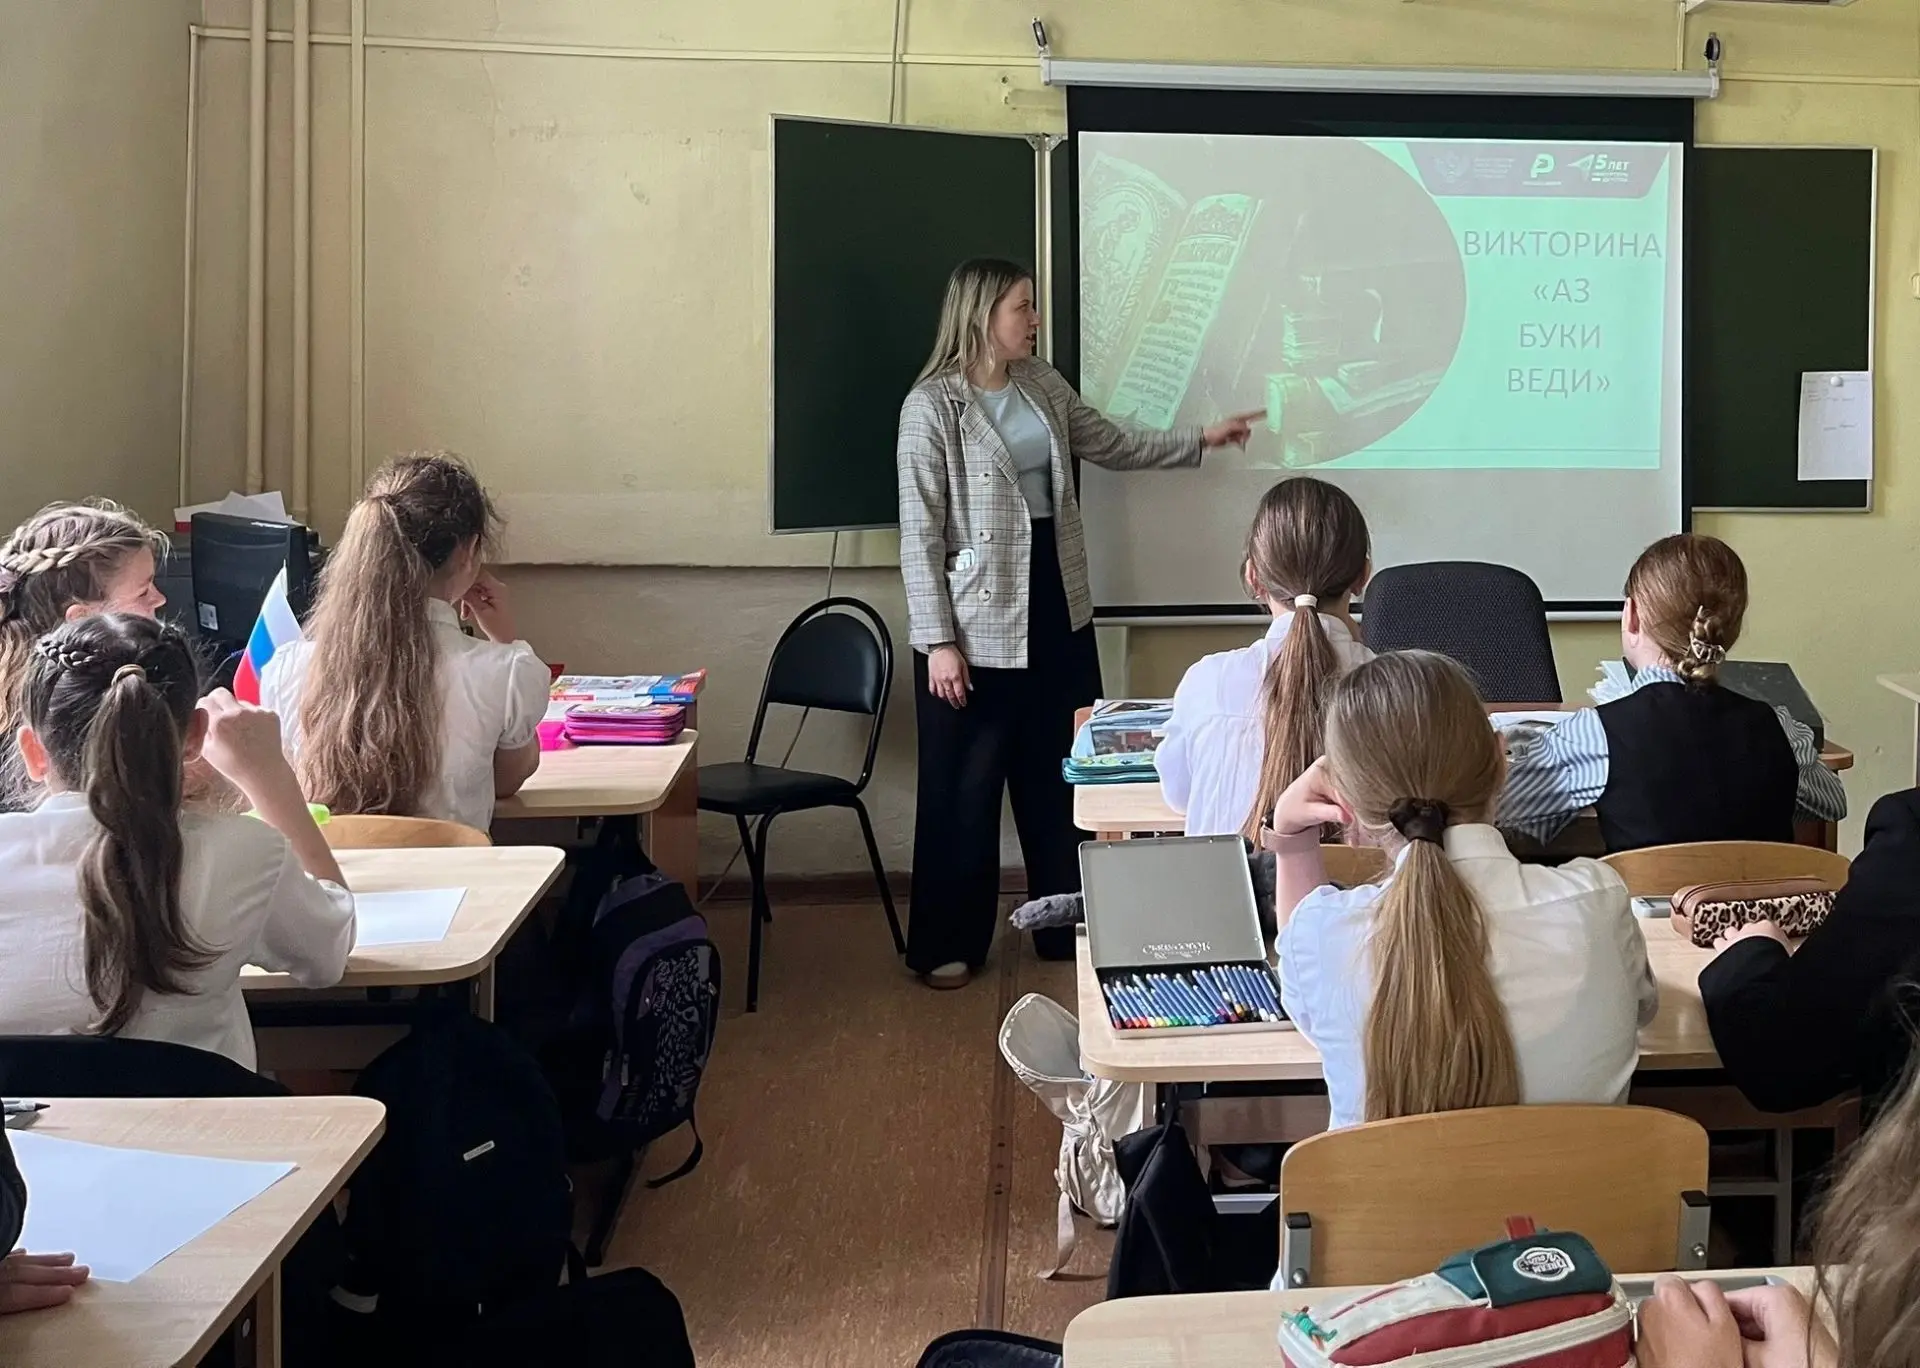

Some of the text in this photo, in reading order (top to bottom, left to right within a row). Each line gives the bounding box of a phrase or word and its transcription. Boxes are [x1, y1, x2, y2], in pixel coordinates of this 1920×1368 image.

[1463, 230, 1662, 258] ВИКТОРИНА
[1533, 278, 1590, 304] «АЗ
[1519, 323, 1601, 349] БУКИ
[1507, 368, 1610, 398] ВЕДИ»
